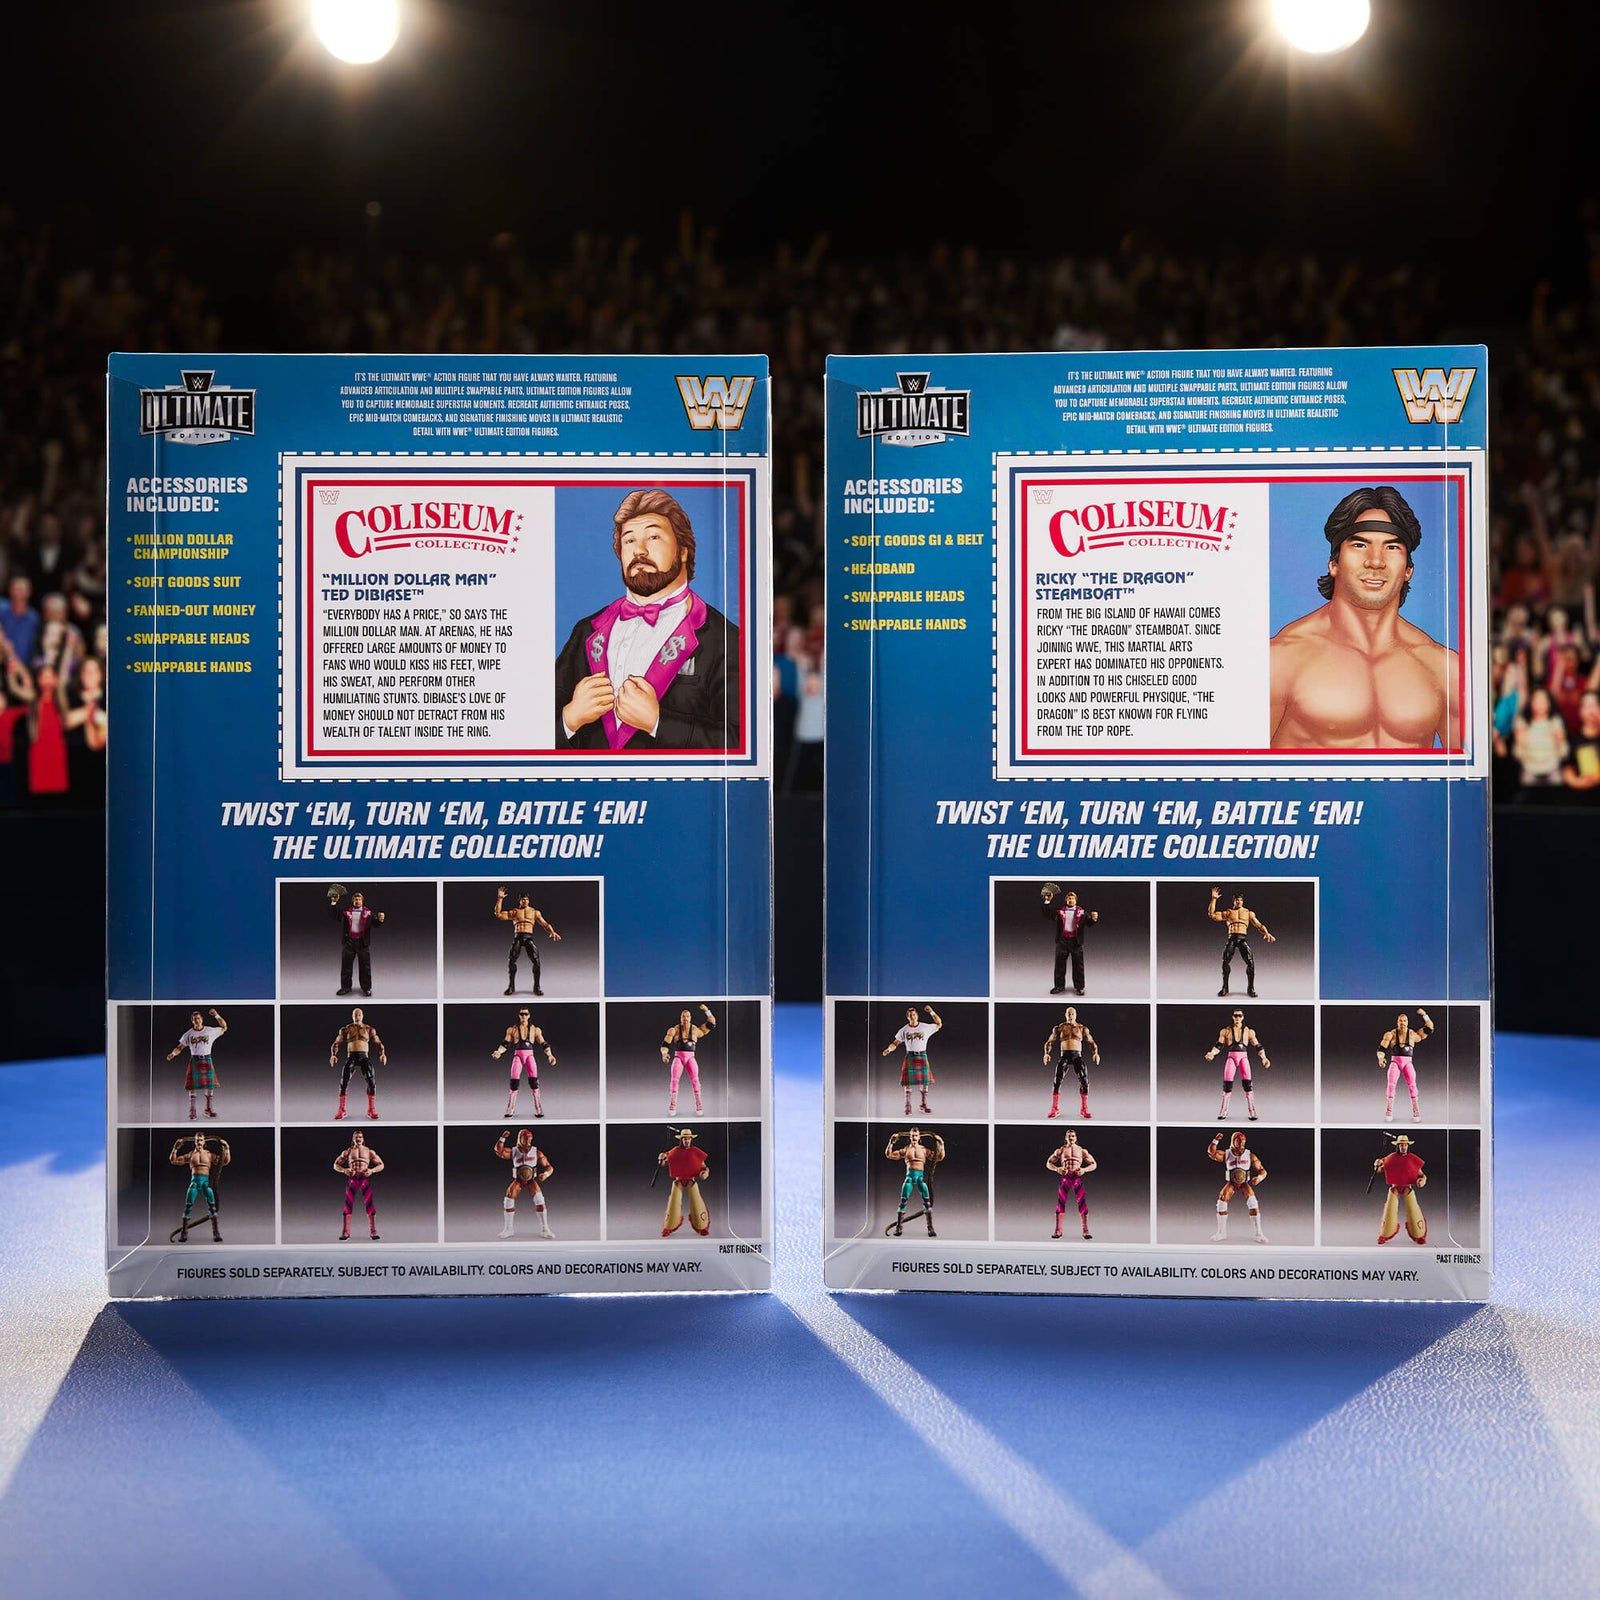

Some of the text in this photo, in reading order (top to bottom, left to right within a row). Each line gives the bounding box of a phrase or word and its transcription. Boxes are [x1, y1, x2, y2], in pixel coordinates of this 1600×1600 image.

[355, 373, 366, 381] IT'S
[368, 373, 379, 381] THE
[381, 373, 410, 381] ULTIMATE
[434, 373, 456, 381] ACTION
[458, 373, 480, 381] FIGURE
[482, 373, 497, 381] THAT
[499, 373, 511, 381] YOU
[513, 373, 528, 382] HAVE
[530, 373, 554, 382] ALWAYS
[556, 373, 582, 382] WANTED.
[584, 373, 617, 382] FEATURING
[146, 395, 250, 429] ULTIMATE
[862, 396, 965, 431] ULTIMATE
[1126, 425, 1147, 434] DETAIL
[1149, 425, 1164, 433] WITH
[1188, 424, 1217, 433] ULTIMATE
[1219, 424, 1244, 432] EDITION
[1246, 423, 1273, 432] FIGURES.
[126, 478, 248, 493] ACCESSORIES
[844, 478, 963, 495] ACCESSORIES
[126, 497, 220, 512] INCLUDED:
[845, 498, 935, 514] INCLUDED:
[335, 502, 515, 559] COLISEUM
[1049, 500, 1229, 557] COLISEUM
[134, 534, 233, 545] MILLION DOLLAR
[851, 534, 983, 547] SOFT GOODS GI & BELT
[1128, 538, 1221, 552] COLLECTION
[134, 548, 229, 559] CHAMPIONSHIP
[415, 540, 506, 555] COLLECTION
[851, 563, 914, 574] HEADBAND
[134, 576, 240, 588] SOFT GOODS SUIT
[394, 574, 450, 586] DOLLAR
[1036, 573, 1077, 586] RICKY
[321, 589, 349, 601] TED
[852, 590, 964, 602] SWAPPABLE HEADS
[134, 604, 255, 616] FANNED-OUT MONEY
[384, 609, 401, 620] HAS
[404, 609, 410, 620] A
[450, 609, 461, 620] SO
[465, 609, 487, 620] SAYS
[490, 609, 507, 620] THE
[1037, 607, 1220, 619] FROM THE BIG ISLAND OF HAWAII COMES
[852, 619, 966, 630] SWAPPABLE HANDS
[1037, 625, 1063, 636] RICKY
[1136, 624, 1191, 635] STEAMBOAT.
[1195, 624, 1221, 635] SINCE
[323, 626, 512, 637] MILLION DOLLAR MAN. AT ARENAS, HE HAS
[134, 633, 250, 644] SWAPPABLE HEADS
[323, 642, 506, 654] OFFERED LARGE AMOUNTS OF MONEY TO
[1037, 641, 1192, 654] JOINING WWE, THIS MARTIAL ARTS
[134, 662, 251, 672] SWAPPABLE HANDS
[1037, 658, 1224, 669] EXPERT HAS DOMINATED HIS OPPONENTS.
[222, 802, 299, 826] TWIST
[367, 802, 431, 825] TURN
[498, 801, 586, 825] BATTLE
[936, 801, 1013, 824] TWIST
[1080, 801, 1145, 824] TURN
[1211, 801, 1301, 824] BATTLE
[273, 834, 604, 859] THE ULTIMATE COLLECTION!
[987, 834, 1319, 859] THE ULTIMATE COLLECTION!
[719, 1245, 734, 1254] PAST
[1437, 1254, 1452, 1263] PAST
[177, 1262, 702, 1280] FIGURES SOLD SEPARATELY. SUBJECT TO AVAILABILITY. COLORS AND DECORATIONS MAY VARY.
[892, 1262, 1419, 1281] FIGURES SOLD SEPARATELY. SUBJECT TO AVAILABILITY. COLORS AND DECORATIONS MAY VARY.
